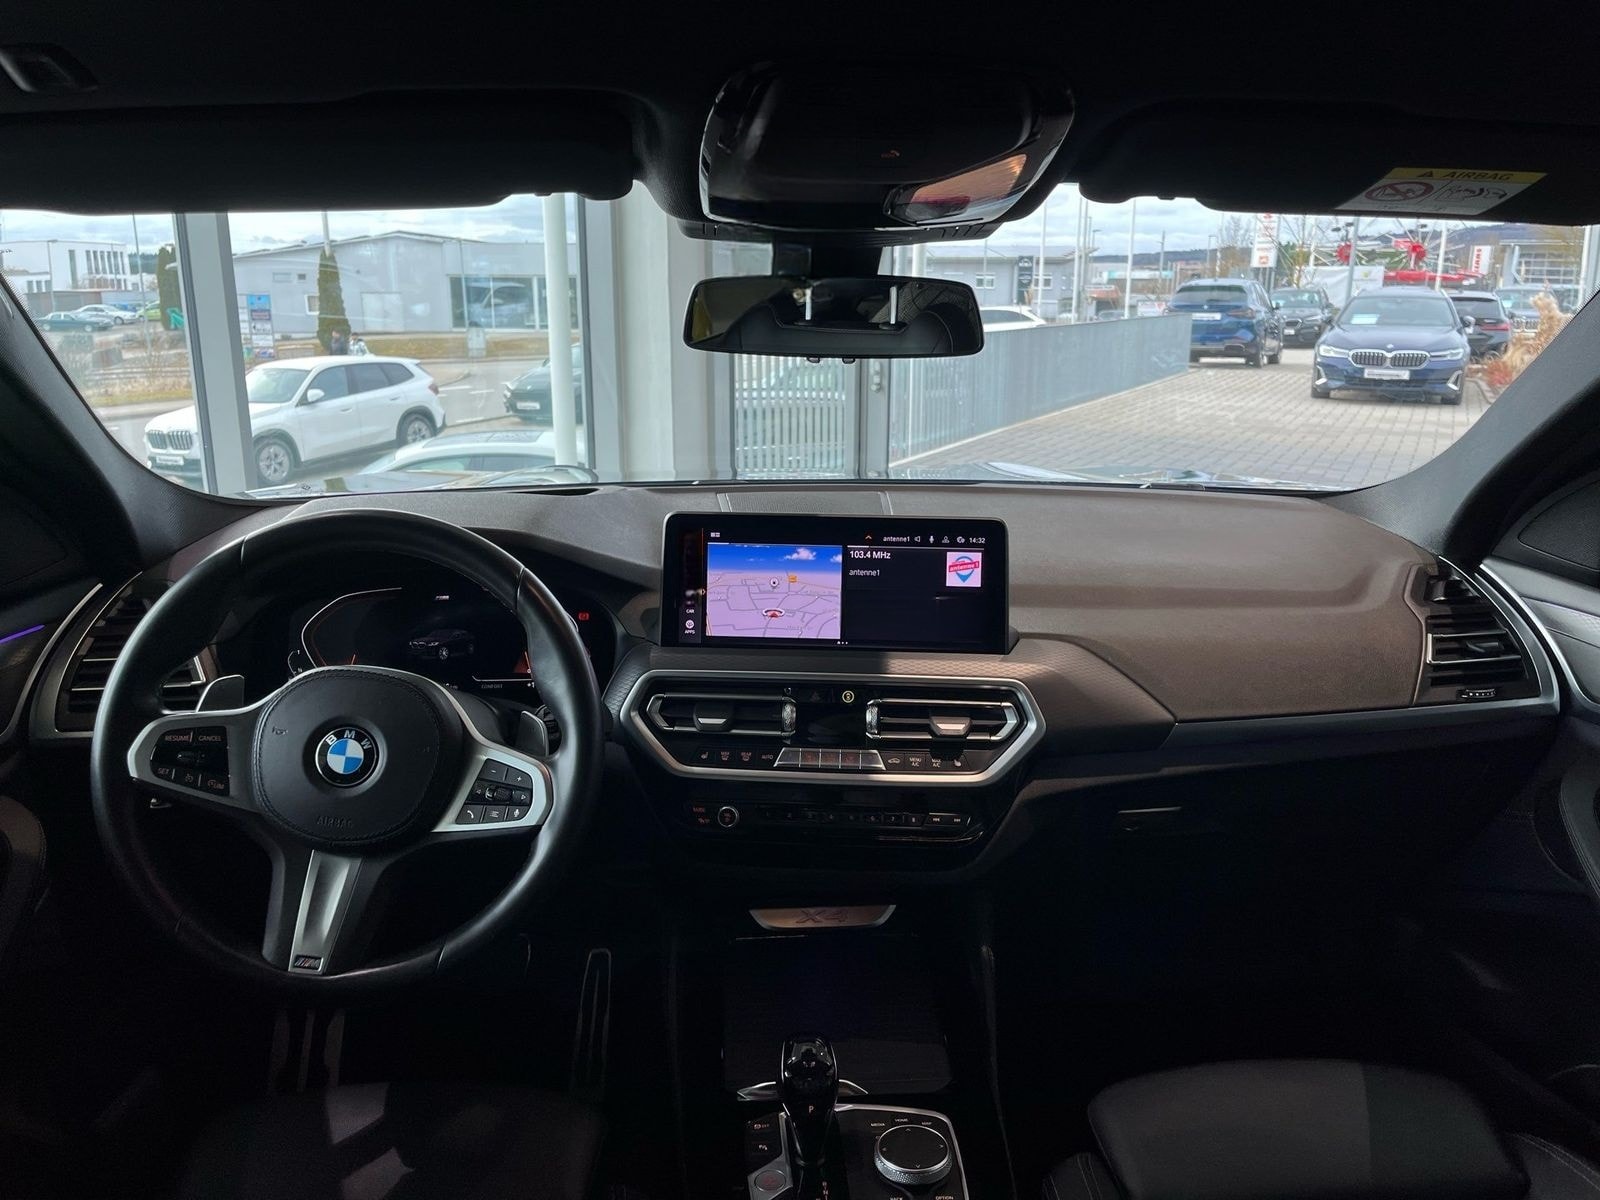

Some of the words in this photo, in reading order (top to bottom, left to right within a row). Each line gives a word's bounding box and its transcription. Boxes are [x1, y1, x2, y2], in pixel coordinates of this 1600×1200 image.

[1443, 171, 1513, 181] AIRBAG
[849, 550, 871, 559] 103.4
[872, 551, 891, 559] MHz
[849, 569, 880, 577] antenne1
[325, 729, 372, 750] BMW
[157, 767, 170, 775] SET
[796, 909, 848, 923] X4
